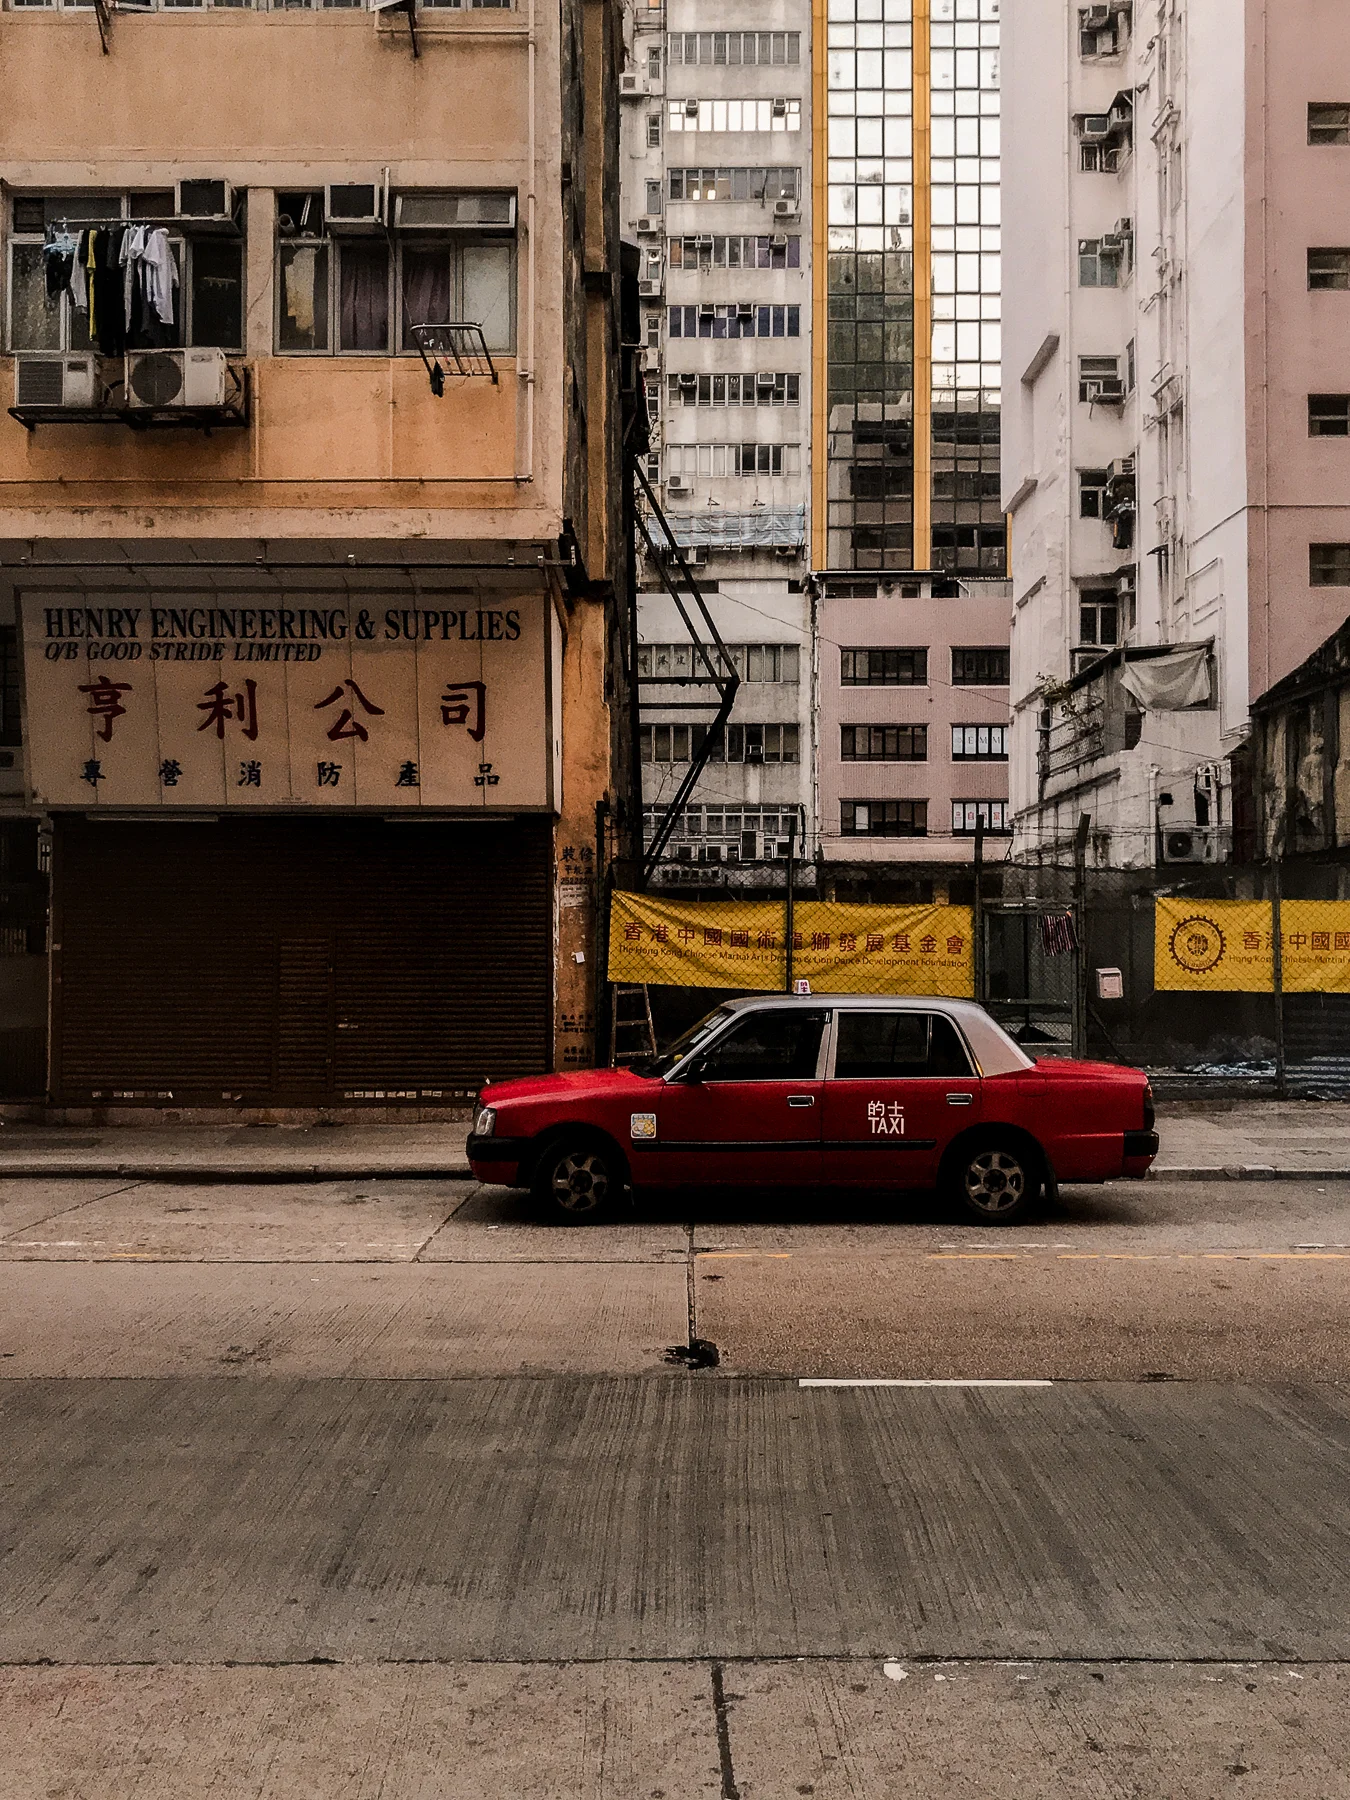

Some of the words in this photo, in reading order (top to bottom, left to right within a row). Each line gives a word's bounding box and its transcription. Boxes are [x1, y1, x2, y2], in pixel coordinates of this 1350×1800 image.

[43, 608, 141, 638] HENRY
[151, 608, 348, 640] ENGINEERING
[355, 609, 376, 640] &
[384, 609, 521, 641] SUPPLIES
[45, 641, 79, 662] O/B
[86, 641, 142, 661] GOOD
[149, 642, 226, 661] STRIDE
[233, 642, 321, 662] LIMITED
[77, 676, 487, 742] 亨利公司
[80, 759, 500, 787] 專營消防產品
[620, 944, 633, 954] The
[636, 946, 658, 957] Hong
[661, 948, 682, 958] Kong
[684, 949, 716, 960] Chinese
[719, 951, 749, 961] Martial
[751, 953, 768, 961] Arts
[771, 953, 801, 964] Draon
[804, 955, 812, 964] &
[814, 956, 831, 965] Lion
[834, 957, 860, 965] Dance
[862, 956, 919, 967] Development
[922, 958, 967, 968] Foundation
[1229, 955, 1252, 964] Hong
[1255, 955, 1273, 963] Kon
[1283, 955, 1313, 963] hinese
[868, 1100, 904, 1117] 的士
[868, 1117, 904, 1134] TAXI
